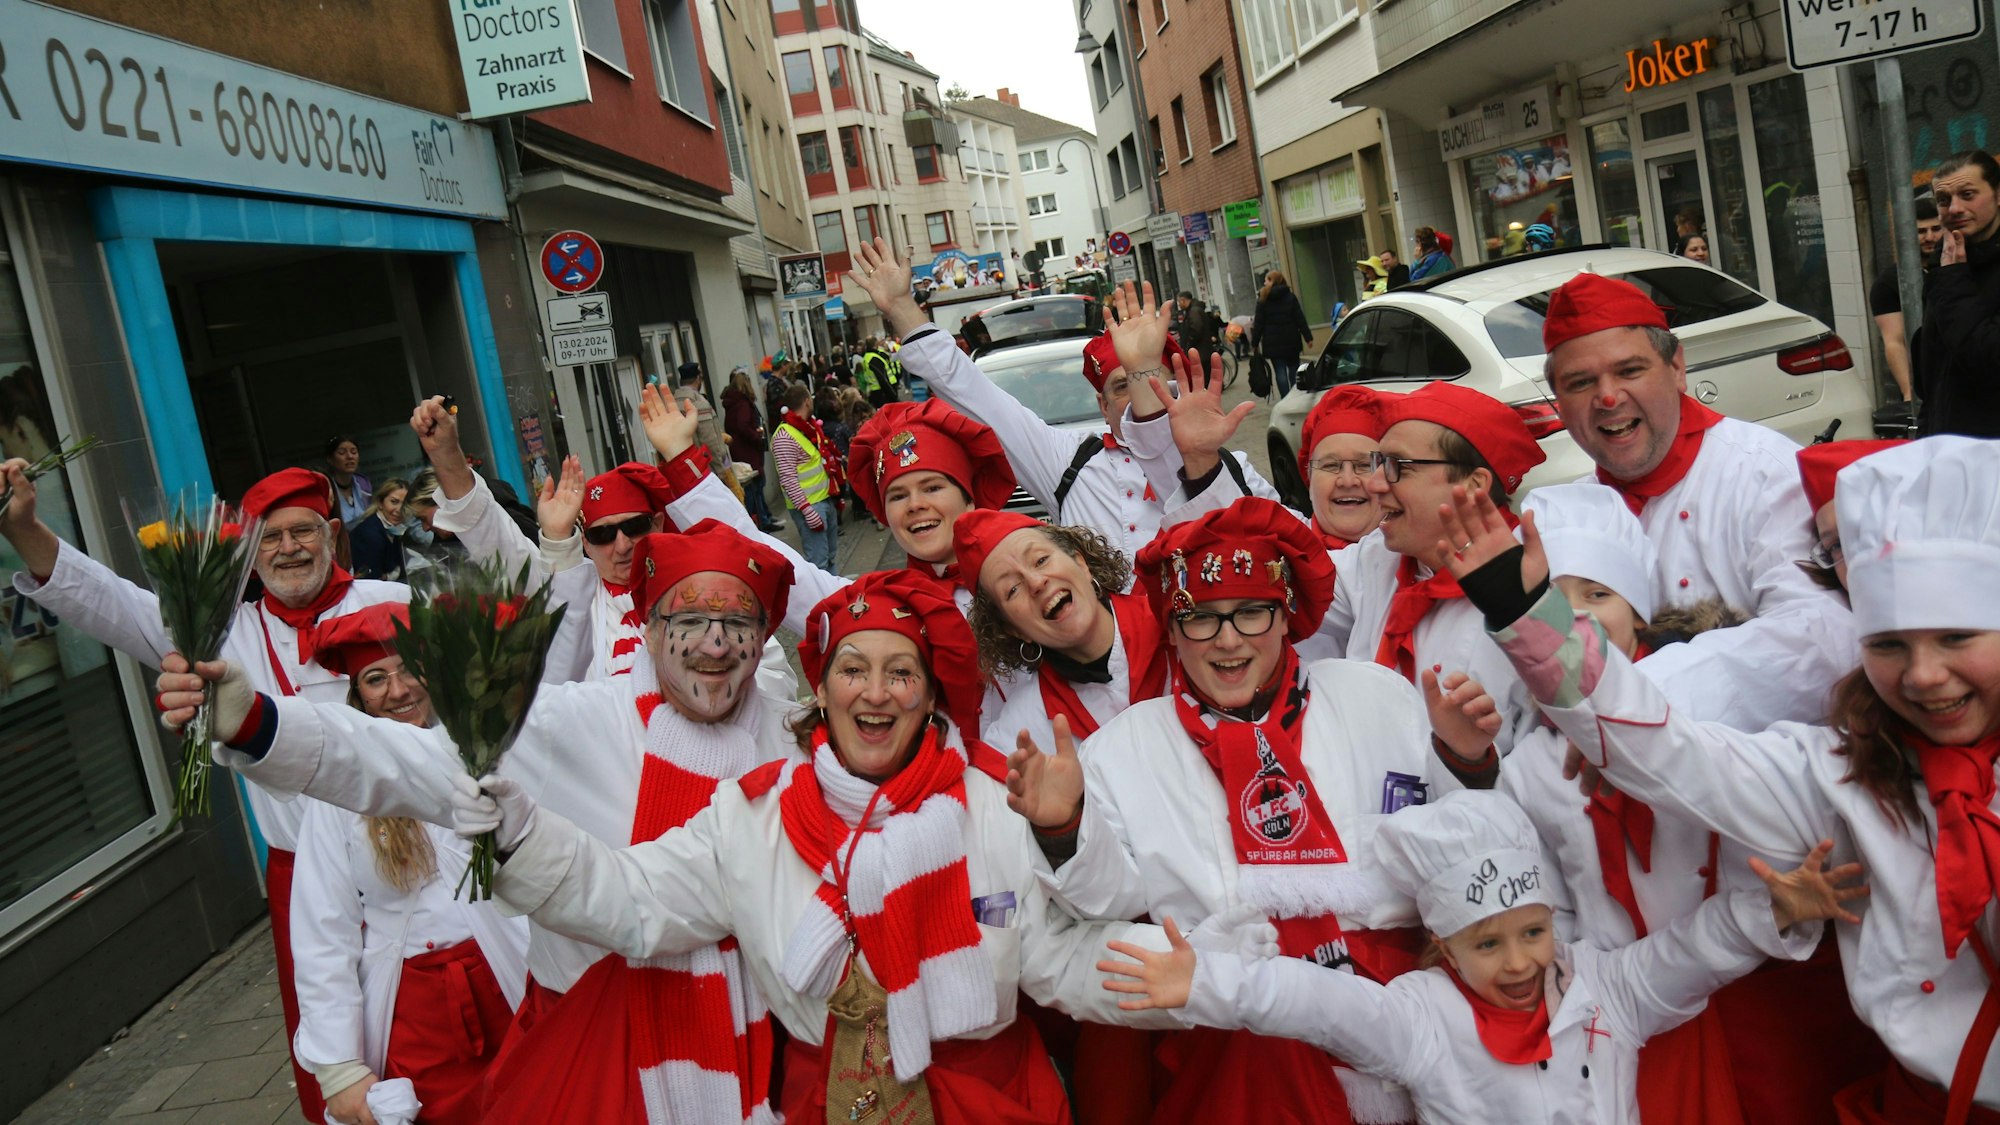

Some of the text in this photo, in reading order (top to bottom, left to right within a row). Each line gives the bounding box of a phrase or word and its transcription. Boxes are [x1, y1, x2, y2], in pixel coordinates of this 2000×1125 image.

[463, 5, 560, 42] Doctors
[1835, 6, 1927, 48] 7-17 h
[476, 46, 566, 77] Zahnarzt
[1624, 38, 1708, 93] Joker
[496, 75, 556, 101] Praxis
[1522, 100, 1539, 129] 25
[411, 129, 437, 166] Fair
[1441, 117, 1490, 152] BUCHHEI
[419, 166, 464, 206] Doctors
[558, 336, 608, 350] 13.02.2024
[561, 346, 608, 360] 09-17 Uhr
[1270, 797, 1290, 817] FC
[1264, 817, 1291, 835] KÖLN
[1246, 847, 1297, 861] SPÜRBAR
[1466, 858, 1498, 905] Big
[1313, 935, 1349, 966] BIN
